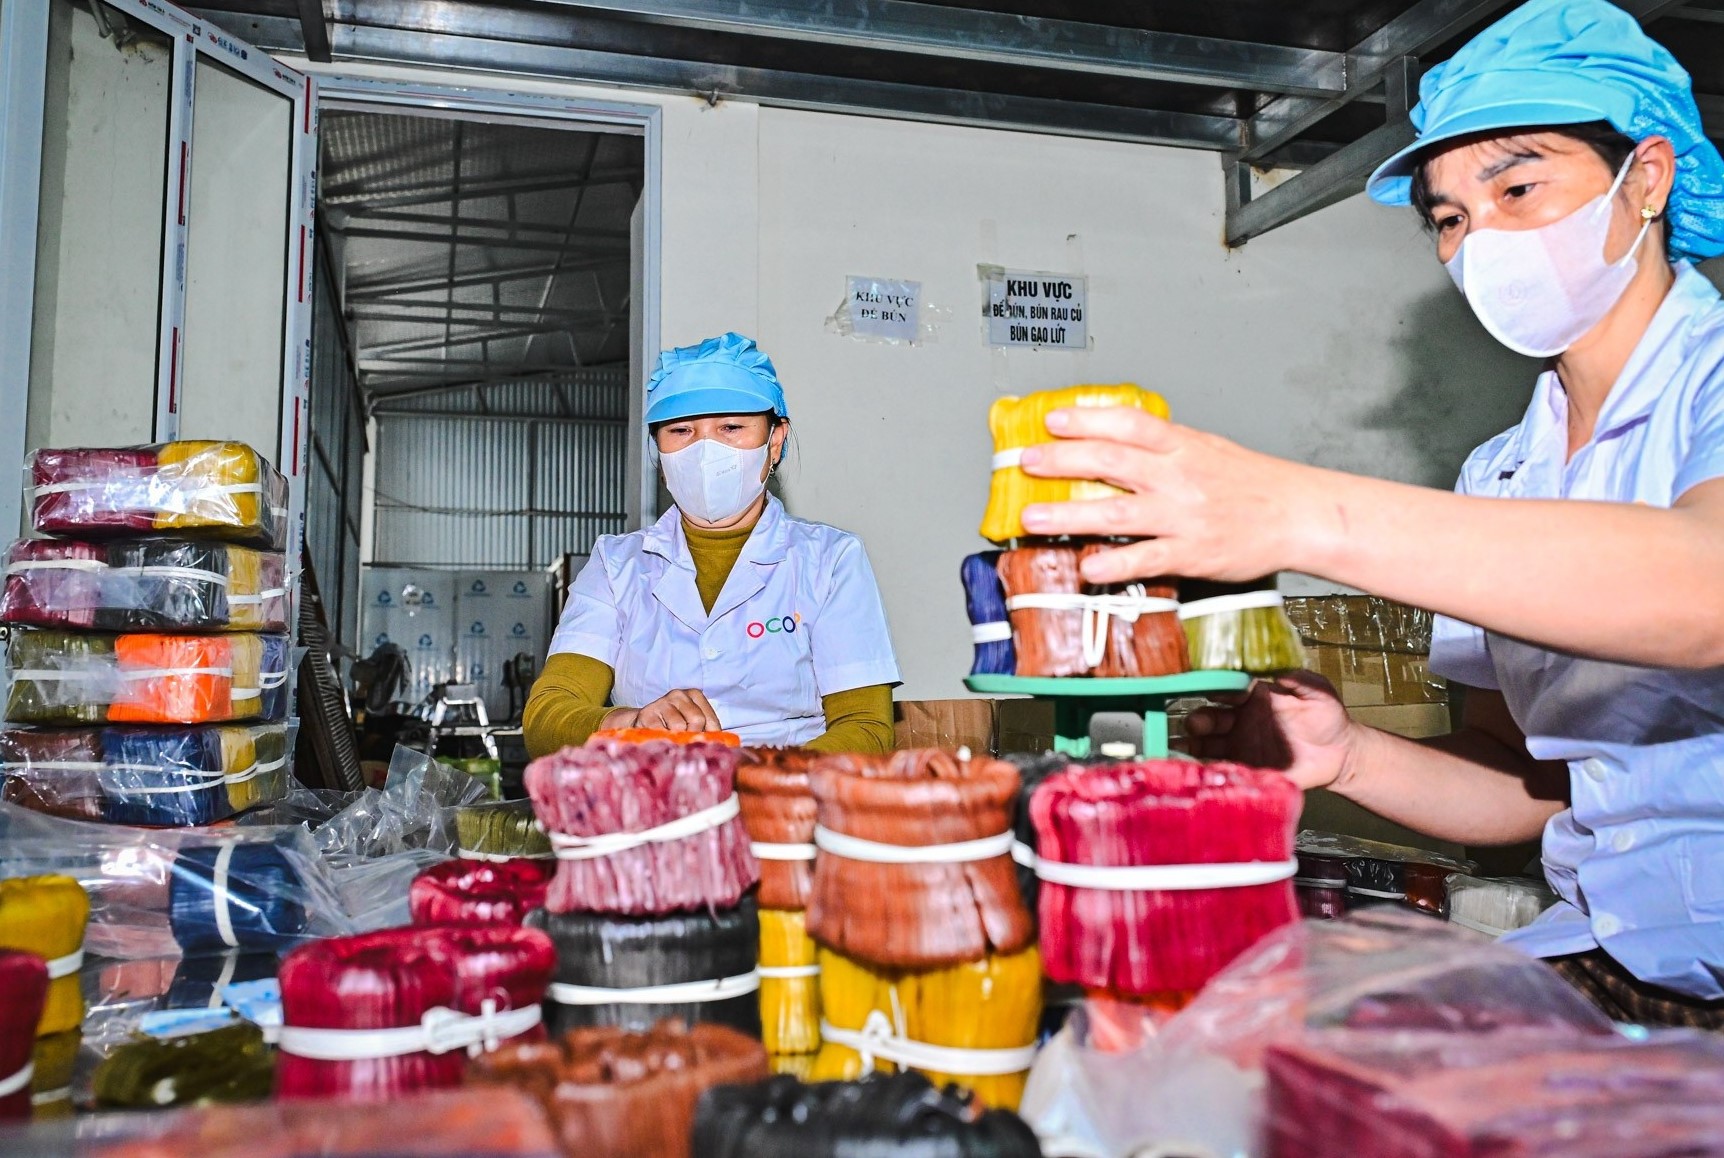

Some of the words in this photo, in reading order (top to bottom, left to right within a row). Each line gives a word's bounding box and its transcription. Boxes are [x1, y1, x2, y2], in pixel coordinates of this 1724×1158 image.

[1007, 279, 1038, 298] KHU
[1042, 280, 1072, 302] VỰC
[1030, 303, 1048, 320] BÚN
[1050, 306, 1068, 321] RAU
[1010, 322, 1028, 342] BÚN
[1031, 325, 1048, 346] GẠO
